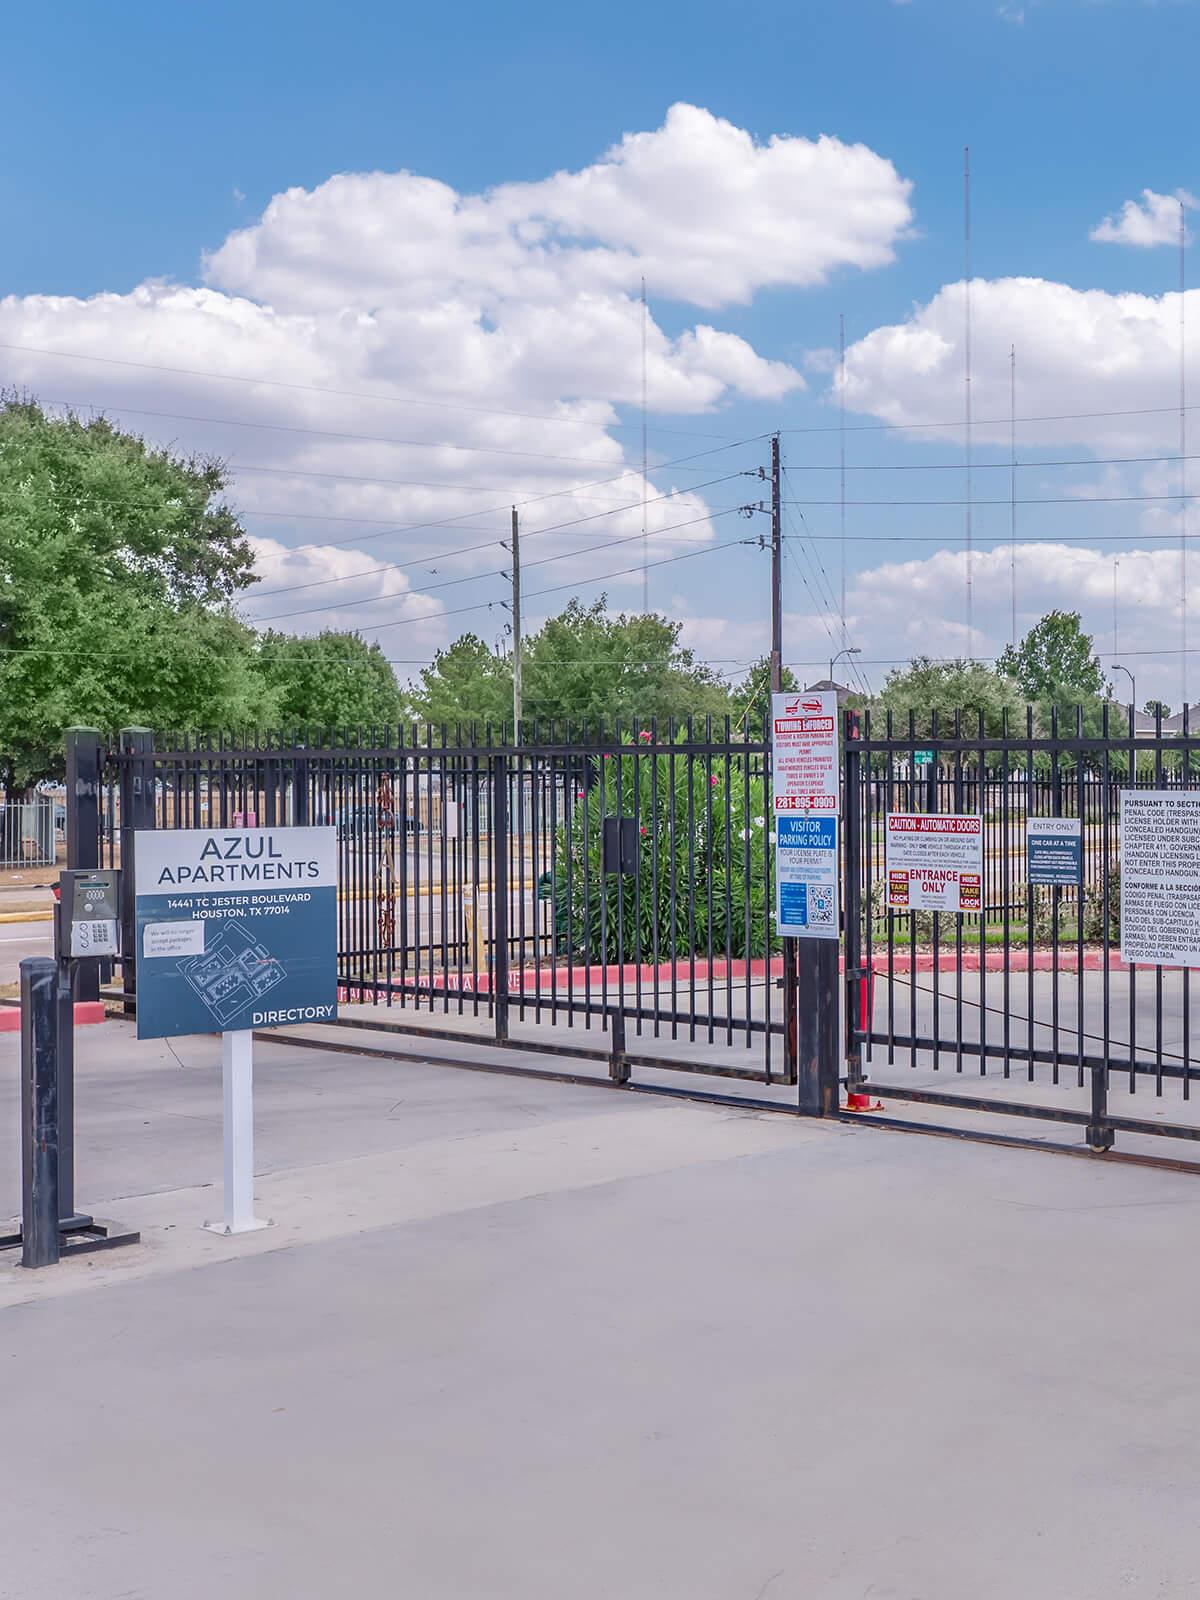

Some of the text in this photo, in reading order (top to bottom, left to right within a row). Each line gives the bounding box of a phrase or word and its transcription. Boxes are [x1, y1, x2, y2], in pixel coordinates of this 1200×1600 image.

[777, 719, 833, 732] TOWING ENFORCED
[1166, 800, 1175, 808] TO
[1124, 809, 1147, 817] PENAL
[890, 818, 916, 830] CAUTION
[921, 819, 956, 831] AUTOMATIC
[957, 820, 980, 832] DOORS
[1124, 817, 1152, 825] LICENSE
[1153, 818, 1180, 826] HOLDER
[790, 821, 821, 833] VISITOR
[1124, 826, 1164, 834] CONCEALED
[780, 834, 832, 846] PARKING POLICY
[1124, 834, 1156, 842] LICENSED
[1157, 835, 1180, 843] UNDER
[200, 836, 282, 861] AZUL
[1124, 842, 1155, 850] CHAPTER
[1160, 852, 1195, 860] LICENSING
[1162, 860, 1177, 868] THIS
[158, 861, 320, 885] APARTMENTS
[910, 869, 958, 882] ENTRANCE
[1124, 867, 1164, 876] CONCEALED
[922, 882, 946, 893] ONLY
[1124, 882, 1158, 890] CONFORME
[890, 894, 909, 902] LOCK
[1147, 892, 1165, 900] PENAL
[167, 894, 311, 909] 14441 TC JESTER BOULEVARD
[960, 898, 980, 906] LOCK
[1124, 899, 1144, 907] ARMAS
[1154, 901, 1174, 909] FUEGO
[192, 906, 290, 920] HOUSTON, TX 77014
[1124, 907, 1195, 919] PERSONAS CON LICENCIA
[1124, 916, 1140, 924] BAJO
[1159, 926, 1189, 935] GOBIERNO
[1149, 934, 1157, 942] NO
[1158, 935, 1177, 943] DEBEN
[1124, 941, 1157, 950] PROPIEDAD
[1157, 943, 1188, 952] PORTANDO
[1189, 945, 1199, 953] UN
[1124, 949, 1145, 958] FUEGO
[253, 1004, 334, 1025] DIRECTORY
